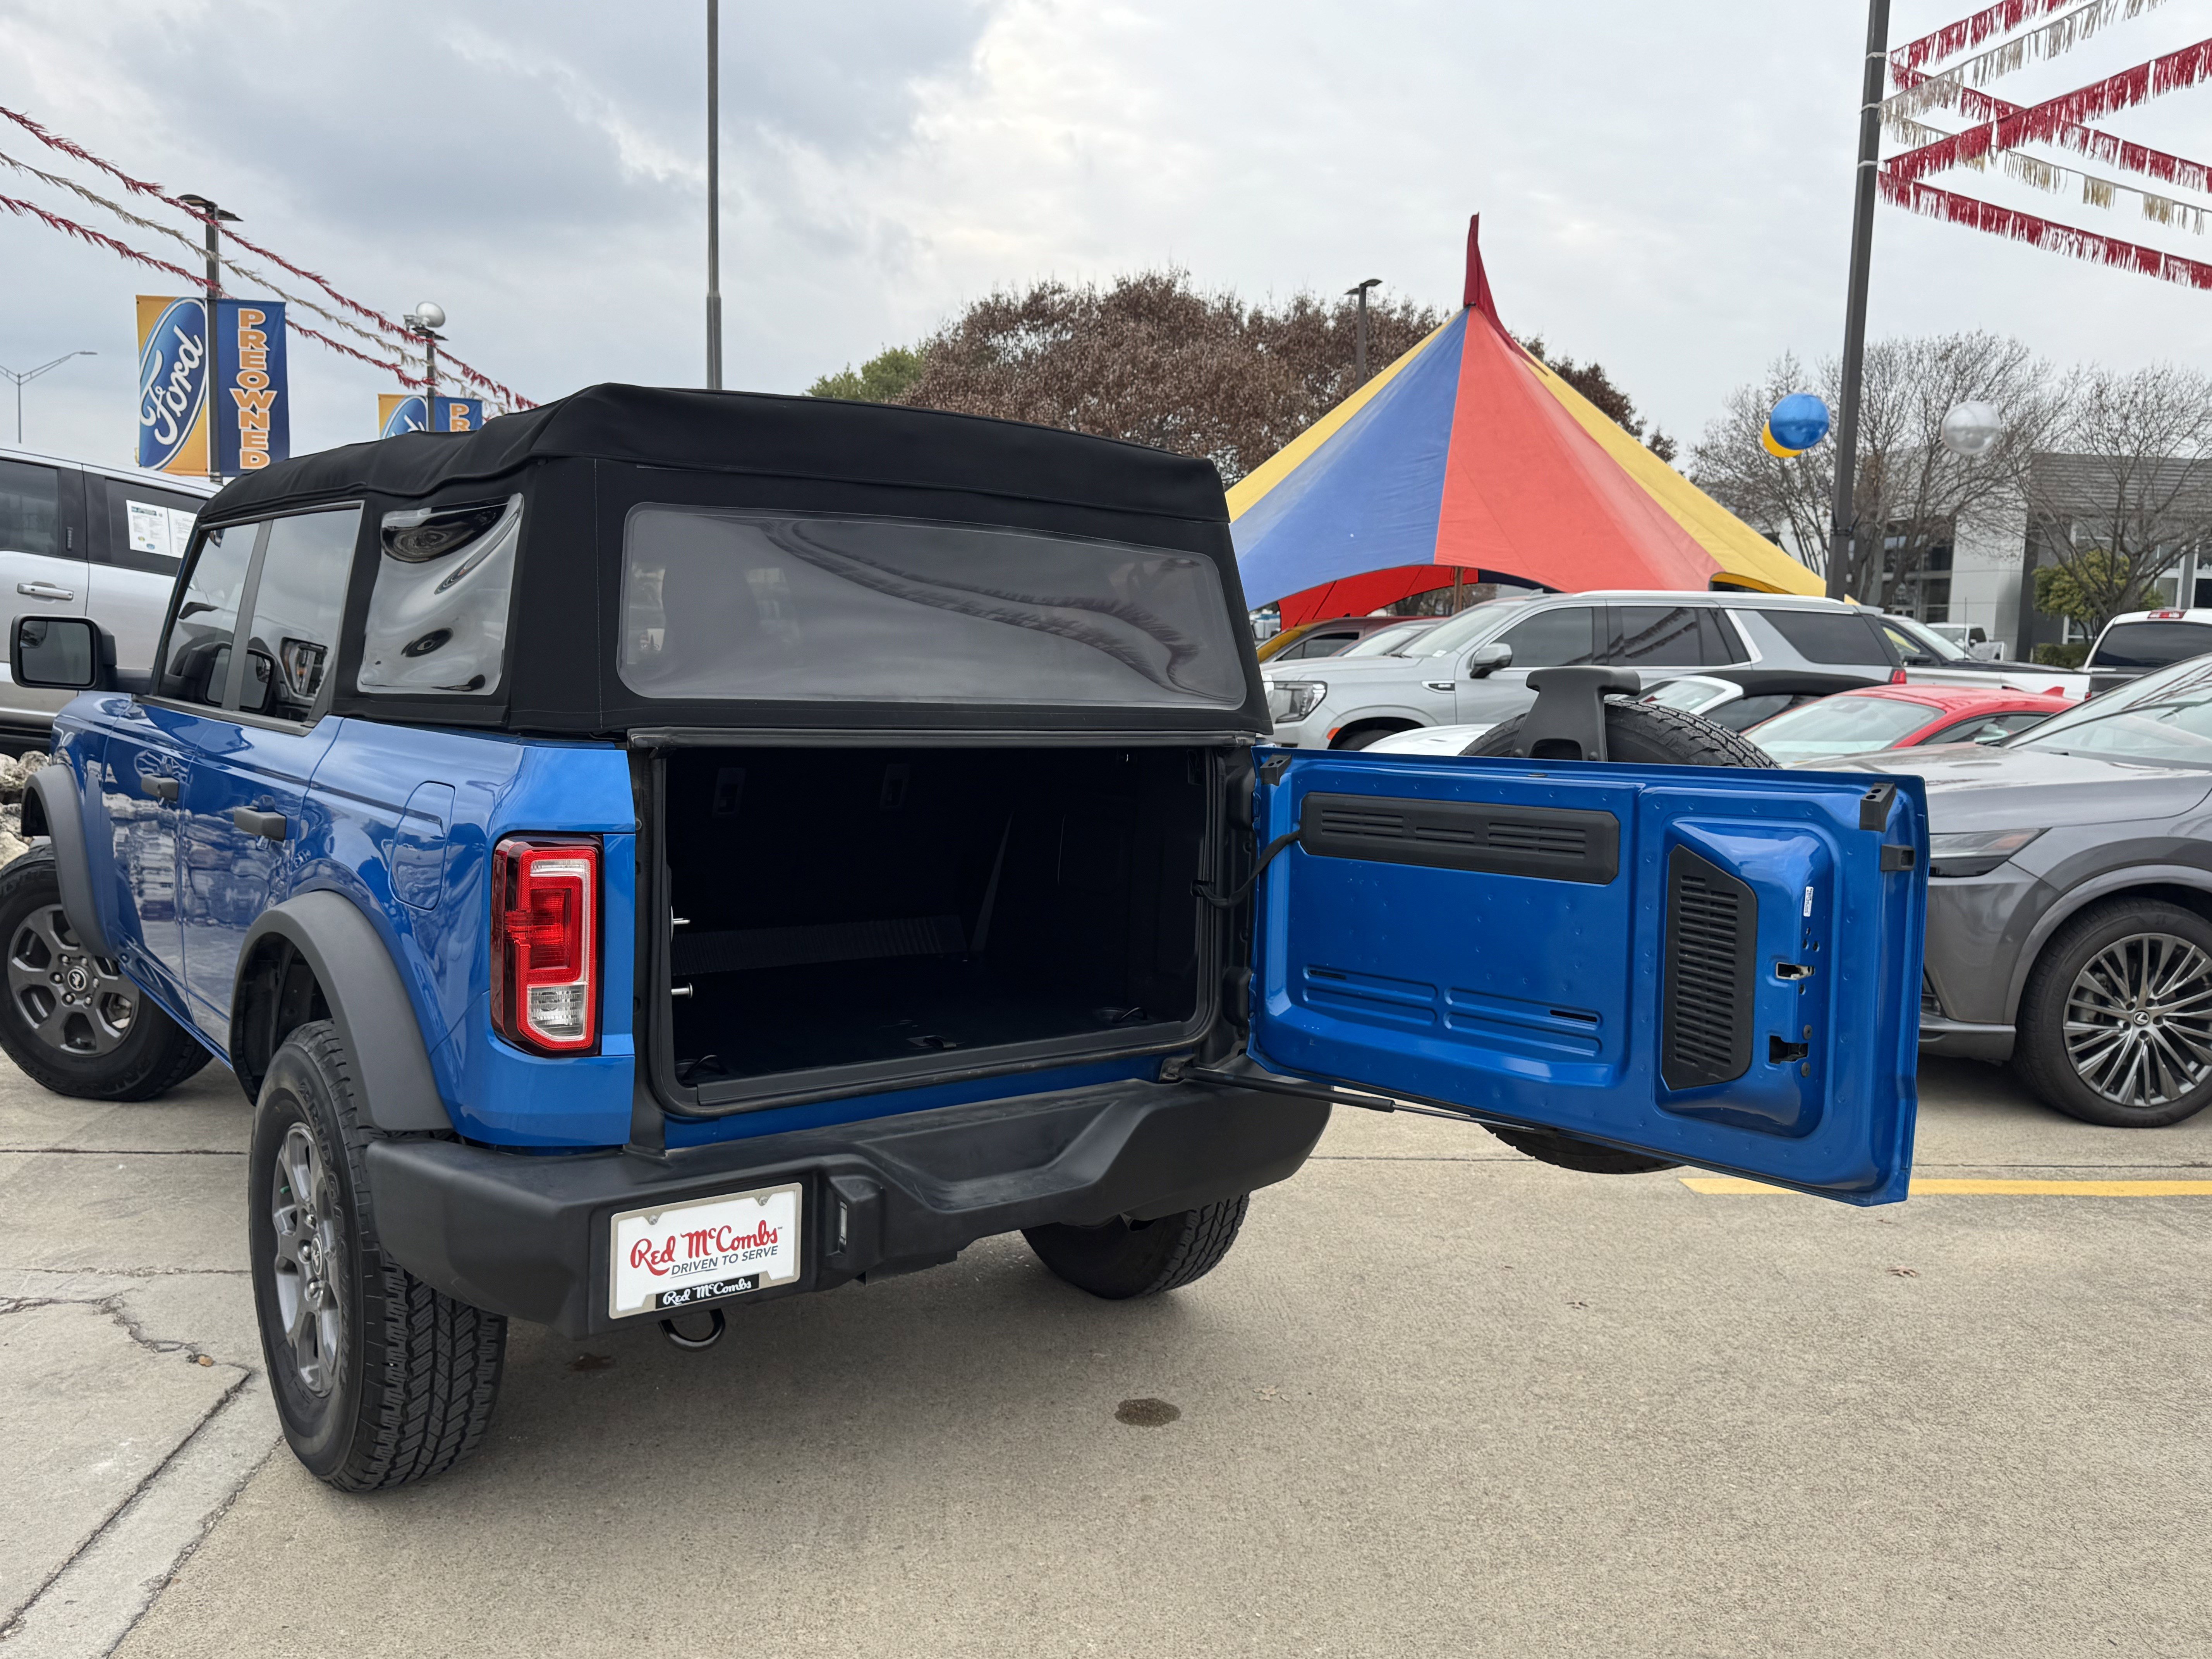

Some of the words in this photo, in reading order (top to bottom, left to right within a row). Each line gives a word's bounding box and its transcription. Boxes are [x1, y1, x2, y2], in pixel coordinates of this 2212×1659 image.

[139, 325, 204, 445] Ford
[229, 308, 277, 469] PREOWNED
[630, 1235, 676, 1276] Red
[680, 1220, 778, 1258] McCombs
[672, 1257, 718, 1275] DRIVEN
[723, 1253, 738, 1265] TO
[742, 1245, 778, 1261] SERVE
[663, 1288, 690, 1305] Red
[692, 1278, 752, 1298] McCombs
